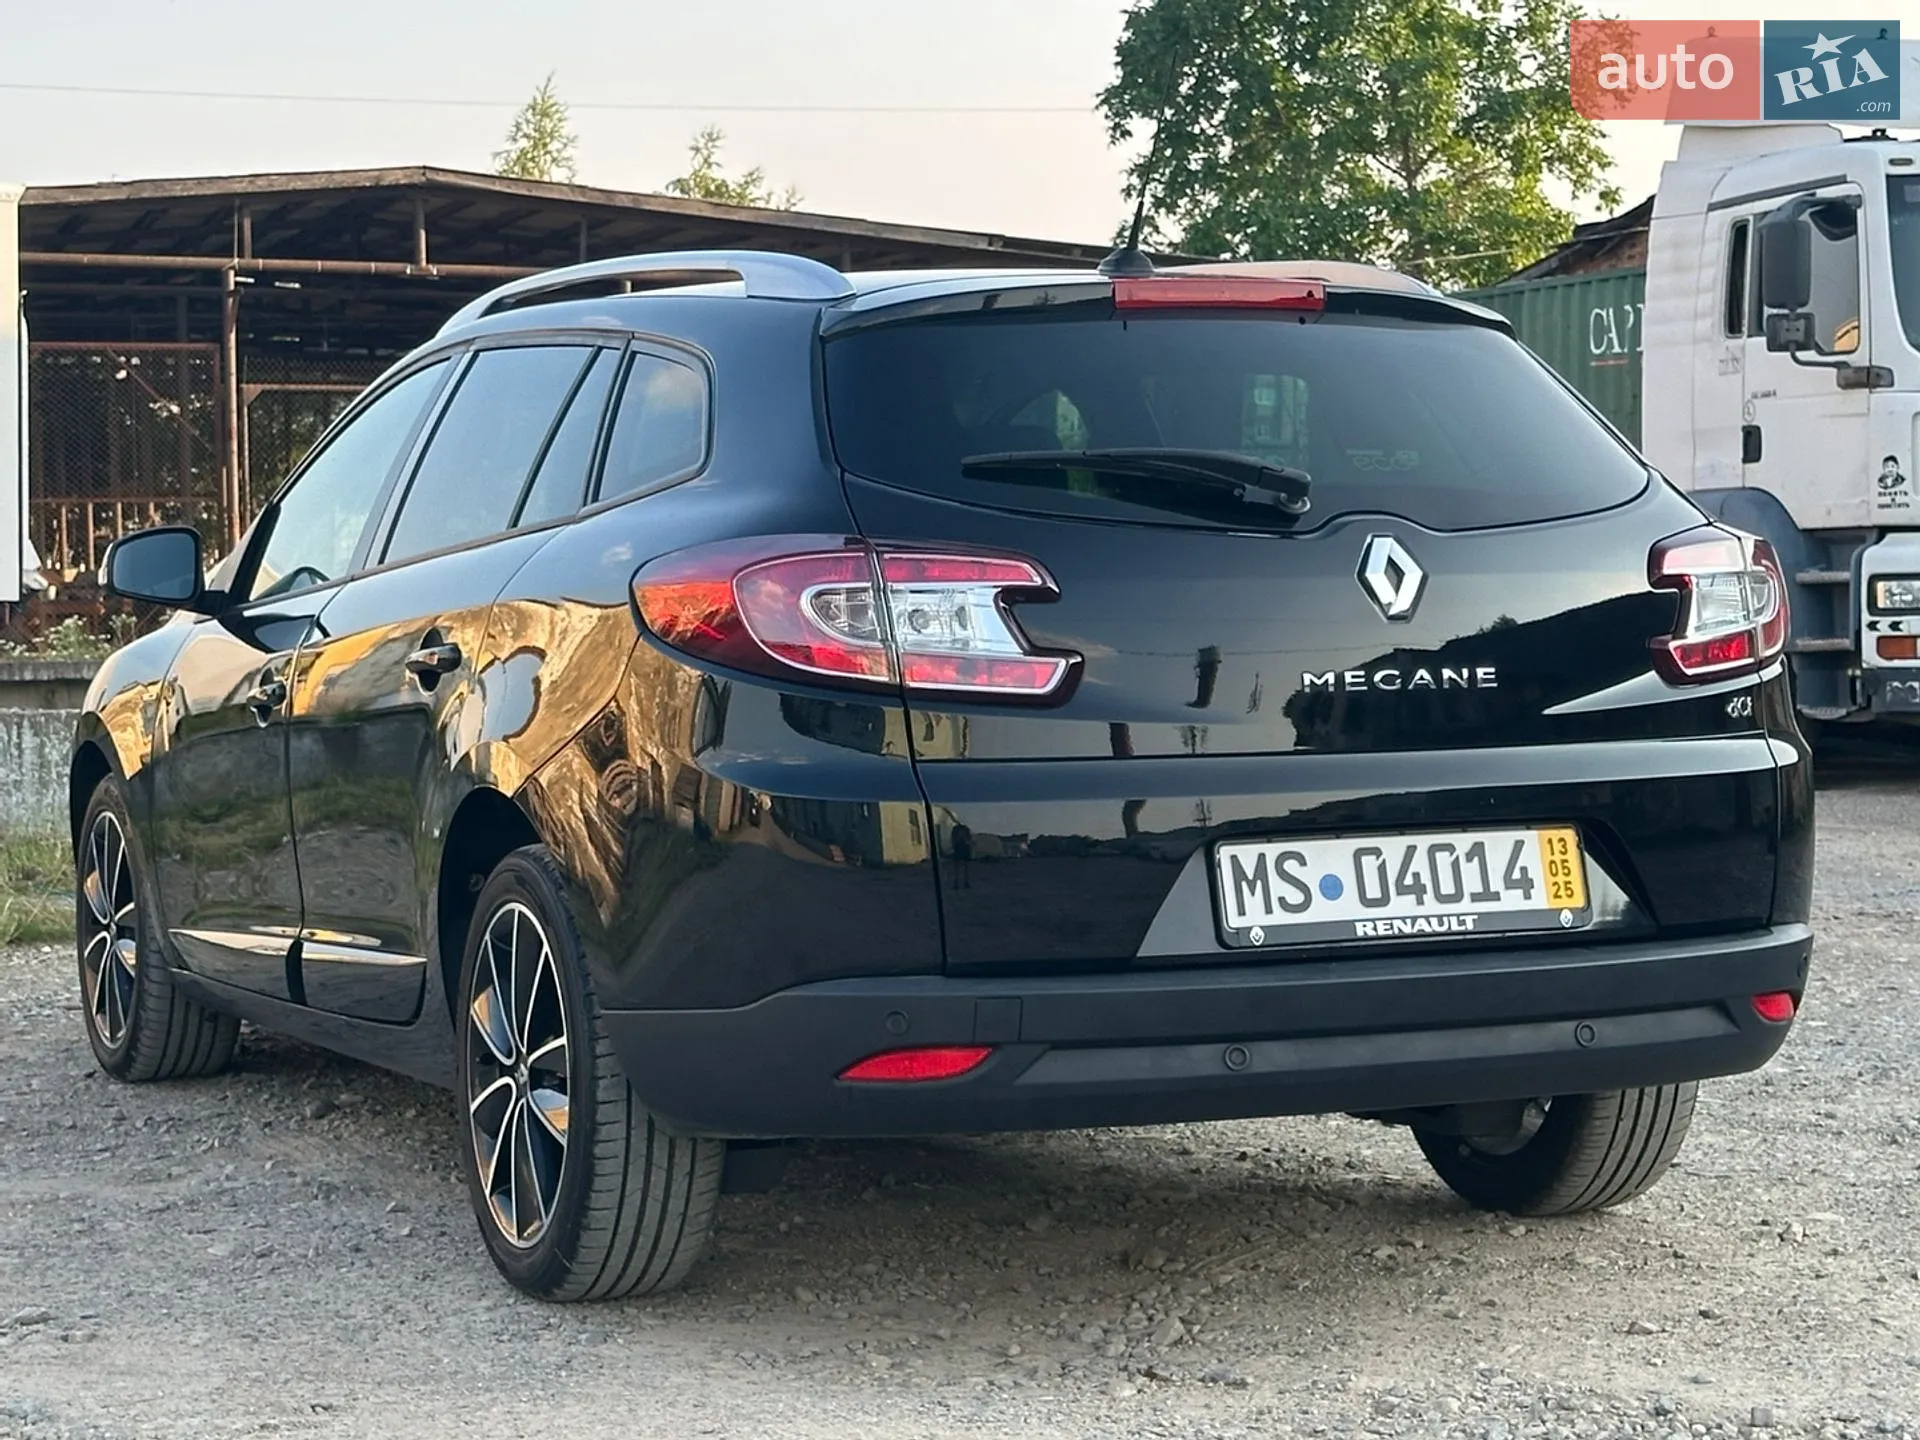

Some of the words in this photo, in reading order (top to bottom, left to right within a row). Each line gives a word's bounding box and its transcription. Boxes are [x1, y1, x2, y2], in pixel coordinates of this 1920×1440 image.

[1590, 303, 1644, 354] CAP
[1302, 667, 1498, 693] MEGANE
[1547, 837, 1568, 856] 13
[1230, 850, 1312, 916] MS
[1353, 839, 1535, 908] 04014
[1549, 859, 1571, 877] 05
[1552, 881, 1575, 899] 25
[1354, 914, 1478, 936] RENAULT
